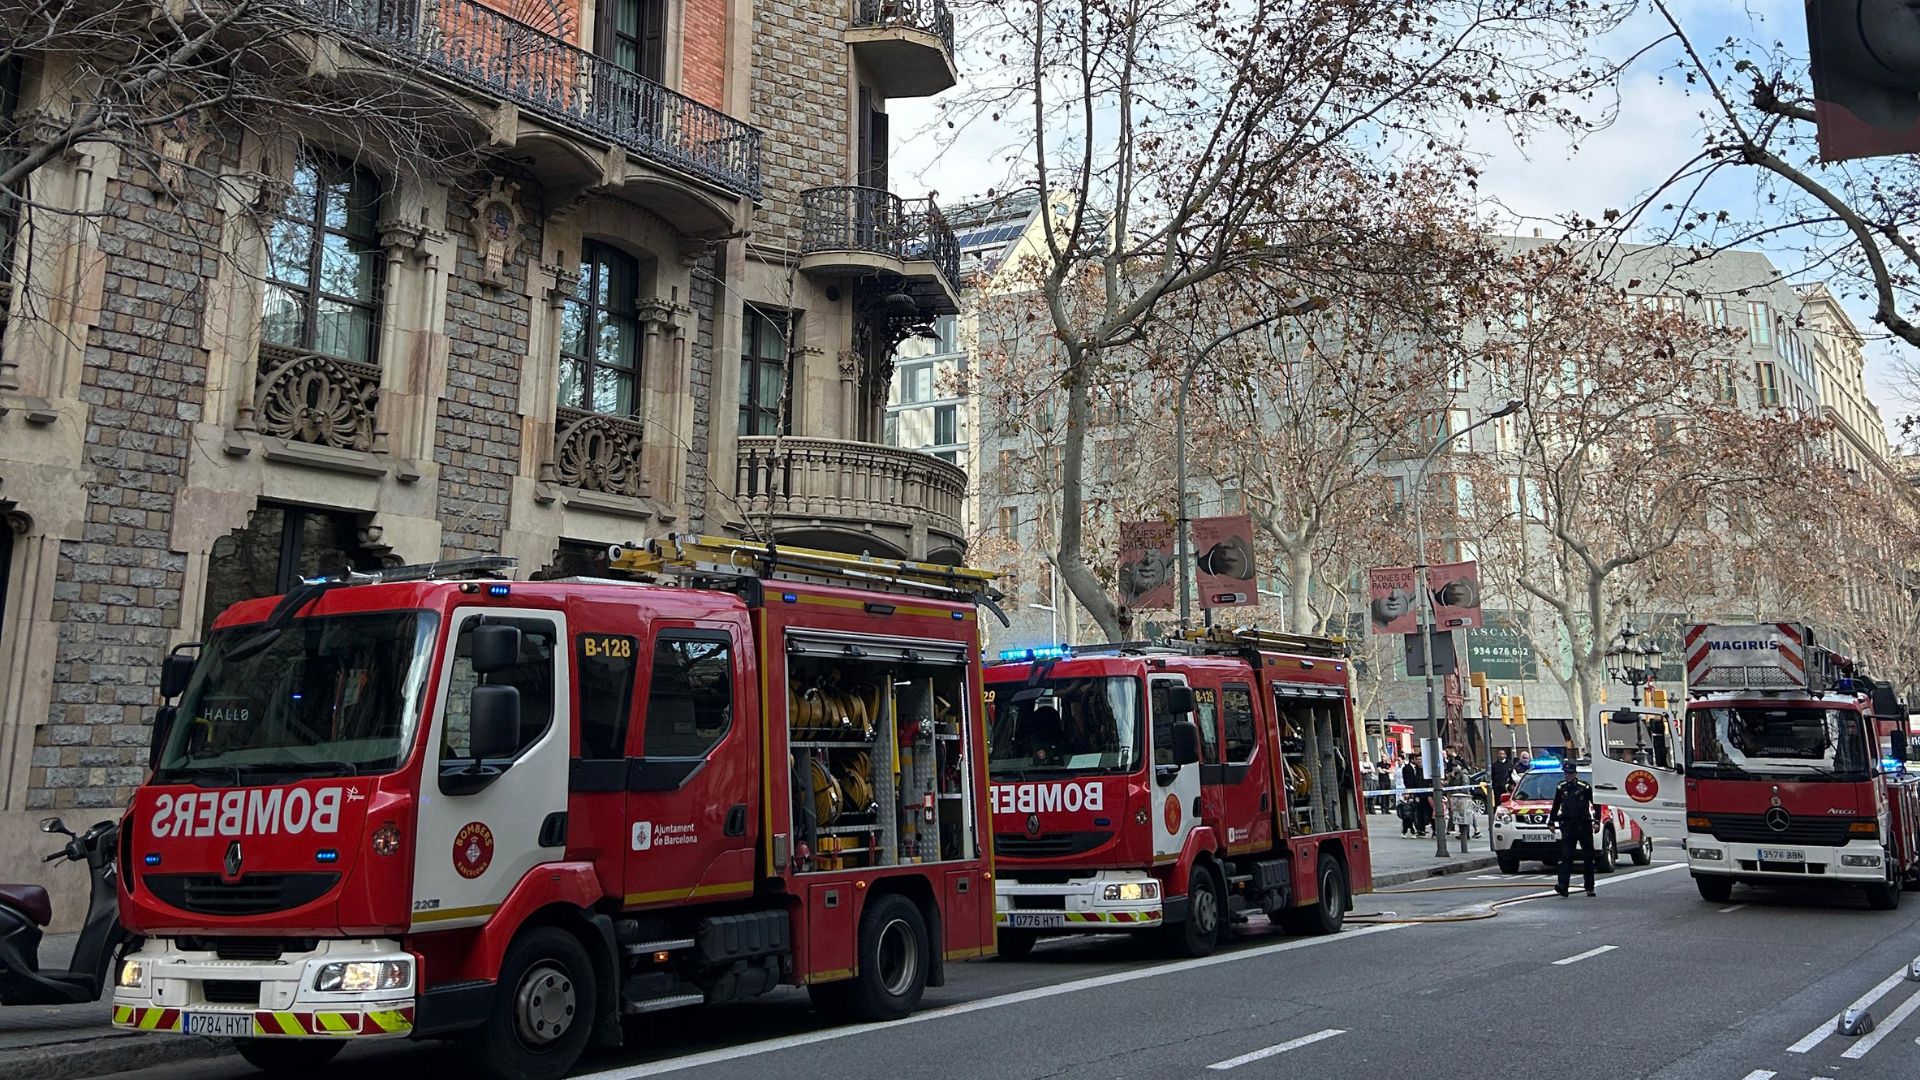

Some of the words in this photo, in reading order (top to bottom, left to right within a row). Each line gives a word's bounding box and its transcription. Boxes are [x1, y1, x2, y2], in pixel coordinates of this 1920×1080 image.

[1371, 574, 1400, 582] DONES
[1402, 573, 1412, 581] DE
[1371, 582, 1409, 590] PARAULA
[1471, 628, 1524, 637] ASCAN
[584, 637, 631, 658] B-128
[1473, 646, 1491, 655] 934
[1708, 640, 1779, 651] MAGIRUS
[455, 824, 493, 847] BOMBERS
[654, 823, 695, 836] Ajuntament
[653, 836, 663, 846] de
[664, 834, 698, 845] Barcelona
[1016, 915, 1040, 927] 0776
[1042, 915, 1061, 927] HYT
[191, 1015, 222, 1034] 0784
[226, 1016, 250, 1035] HYT
